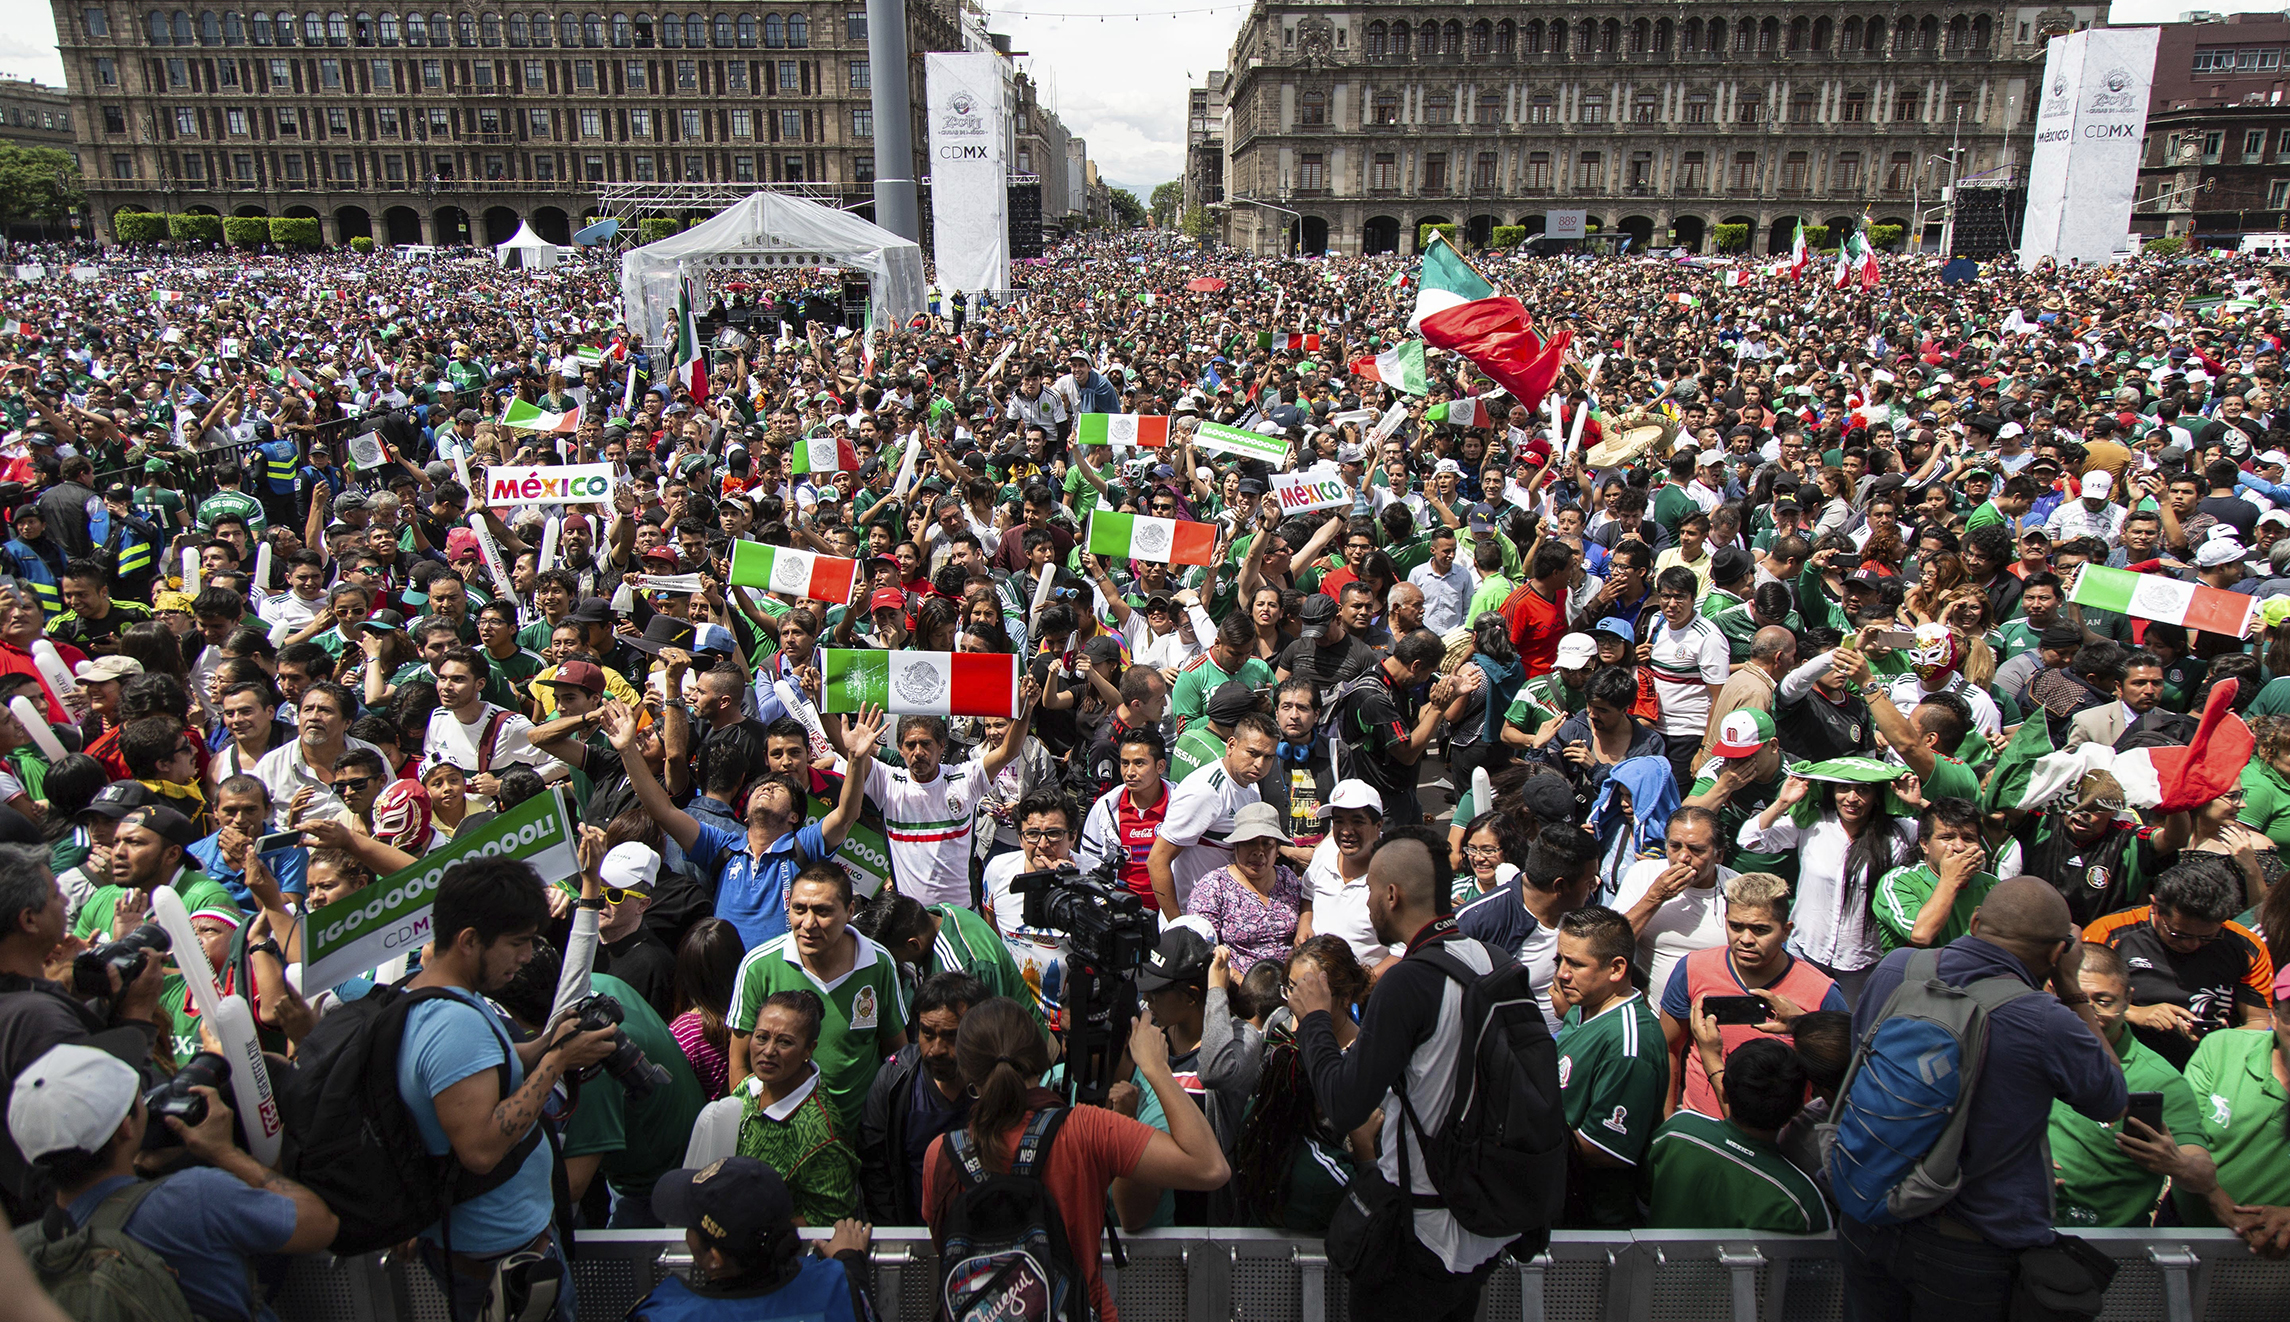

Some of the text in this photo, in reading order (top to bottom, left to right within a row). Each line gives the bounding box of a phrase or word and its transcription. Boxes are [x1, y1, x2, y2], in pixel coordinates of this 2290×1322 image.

[2084, 124, 2135, 138] CDMX
[940, 145, 988, 159] CDMX
[1558, 216, 1577, 226] 889
[316, 813, 556, 949] ¡GOOOOOOOOL!
[384, 913, 434, 949] CDM
[701, 1214, 727, 1239] SSP
